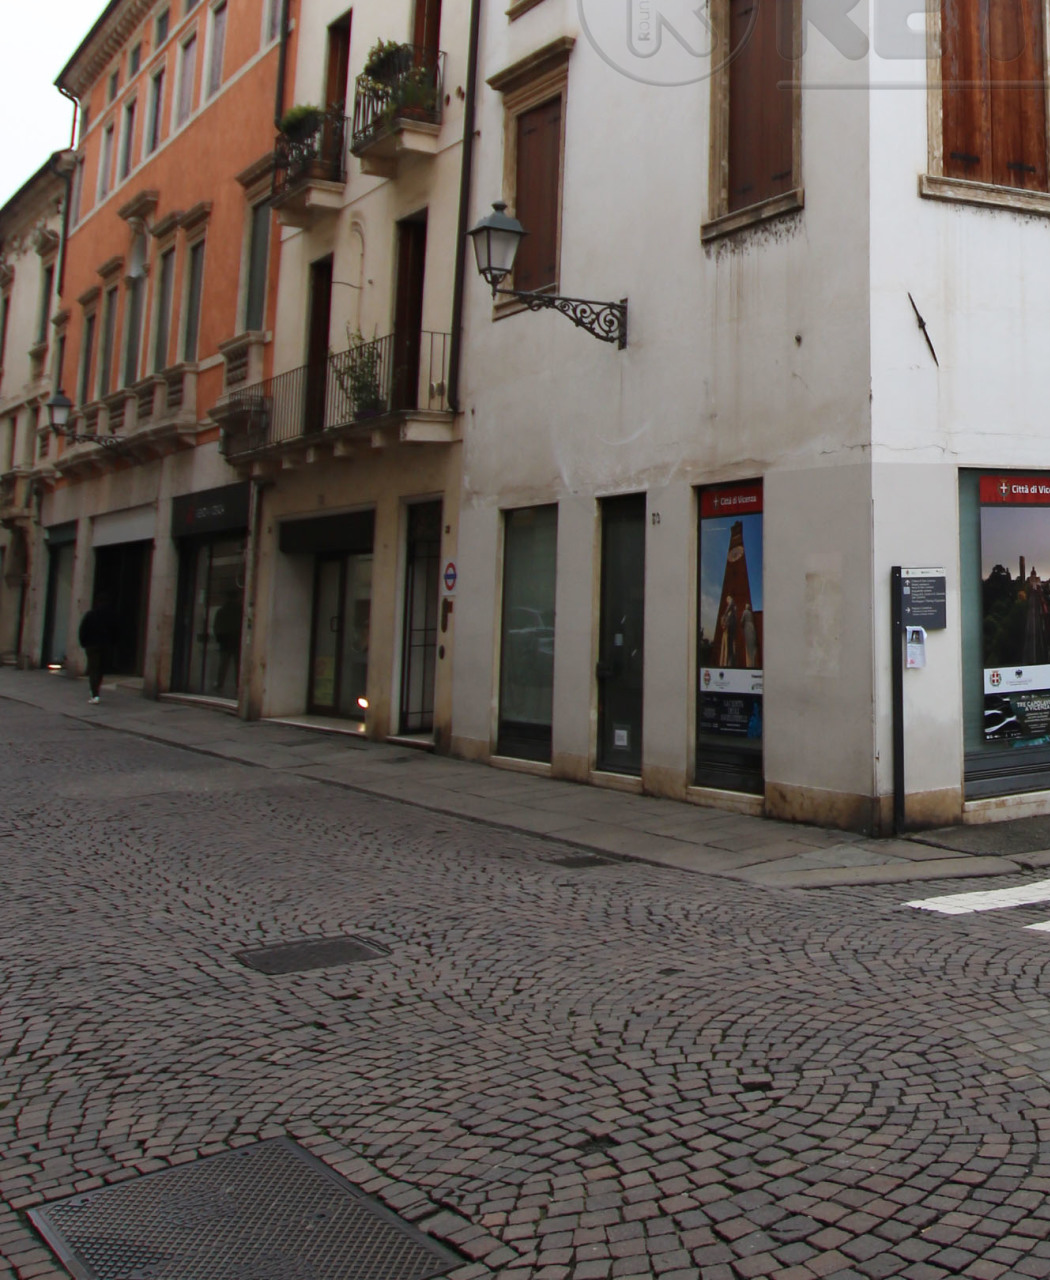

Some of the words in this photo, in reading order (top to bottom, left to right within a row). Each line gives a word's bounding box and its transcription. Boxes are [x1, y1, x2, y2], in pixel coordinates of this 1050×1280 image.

[1011, 484, 1030, 494] Città
[1030, 485, 1037, 494] di
[737, 495, 757, 504] Vicenza
